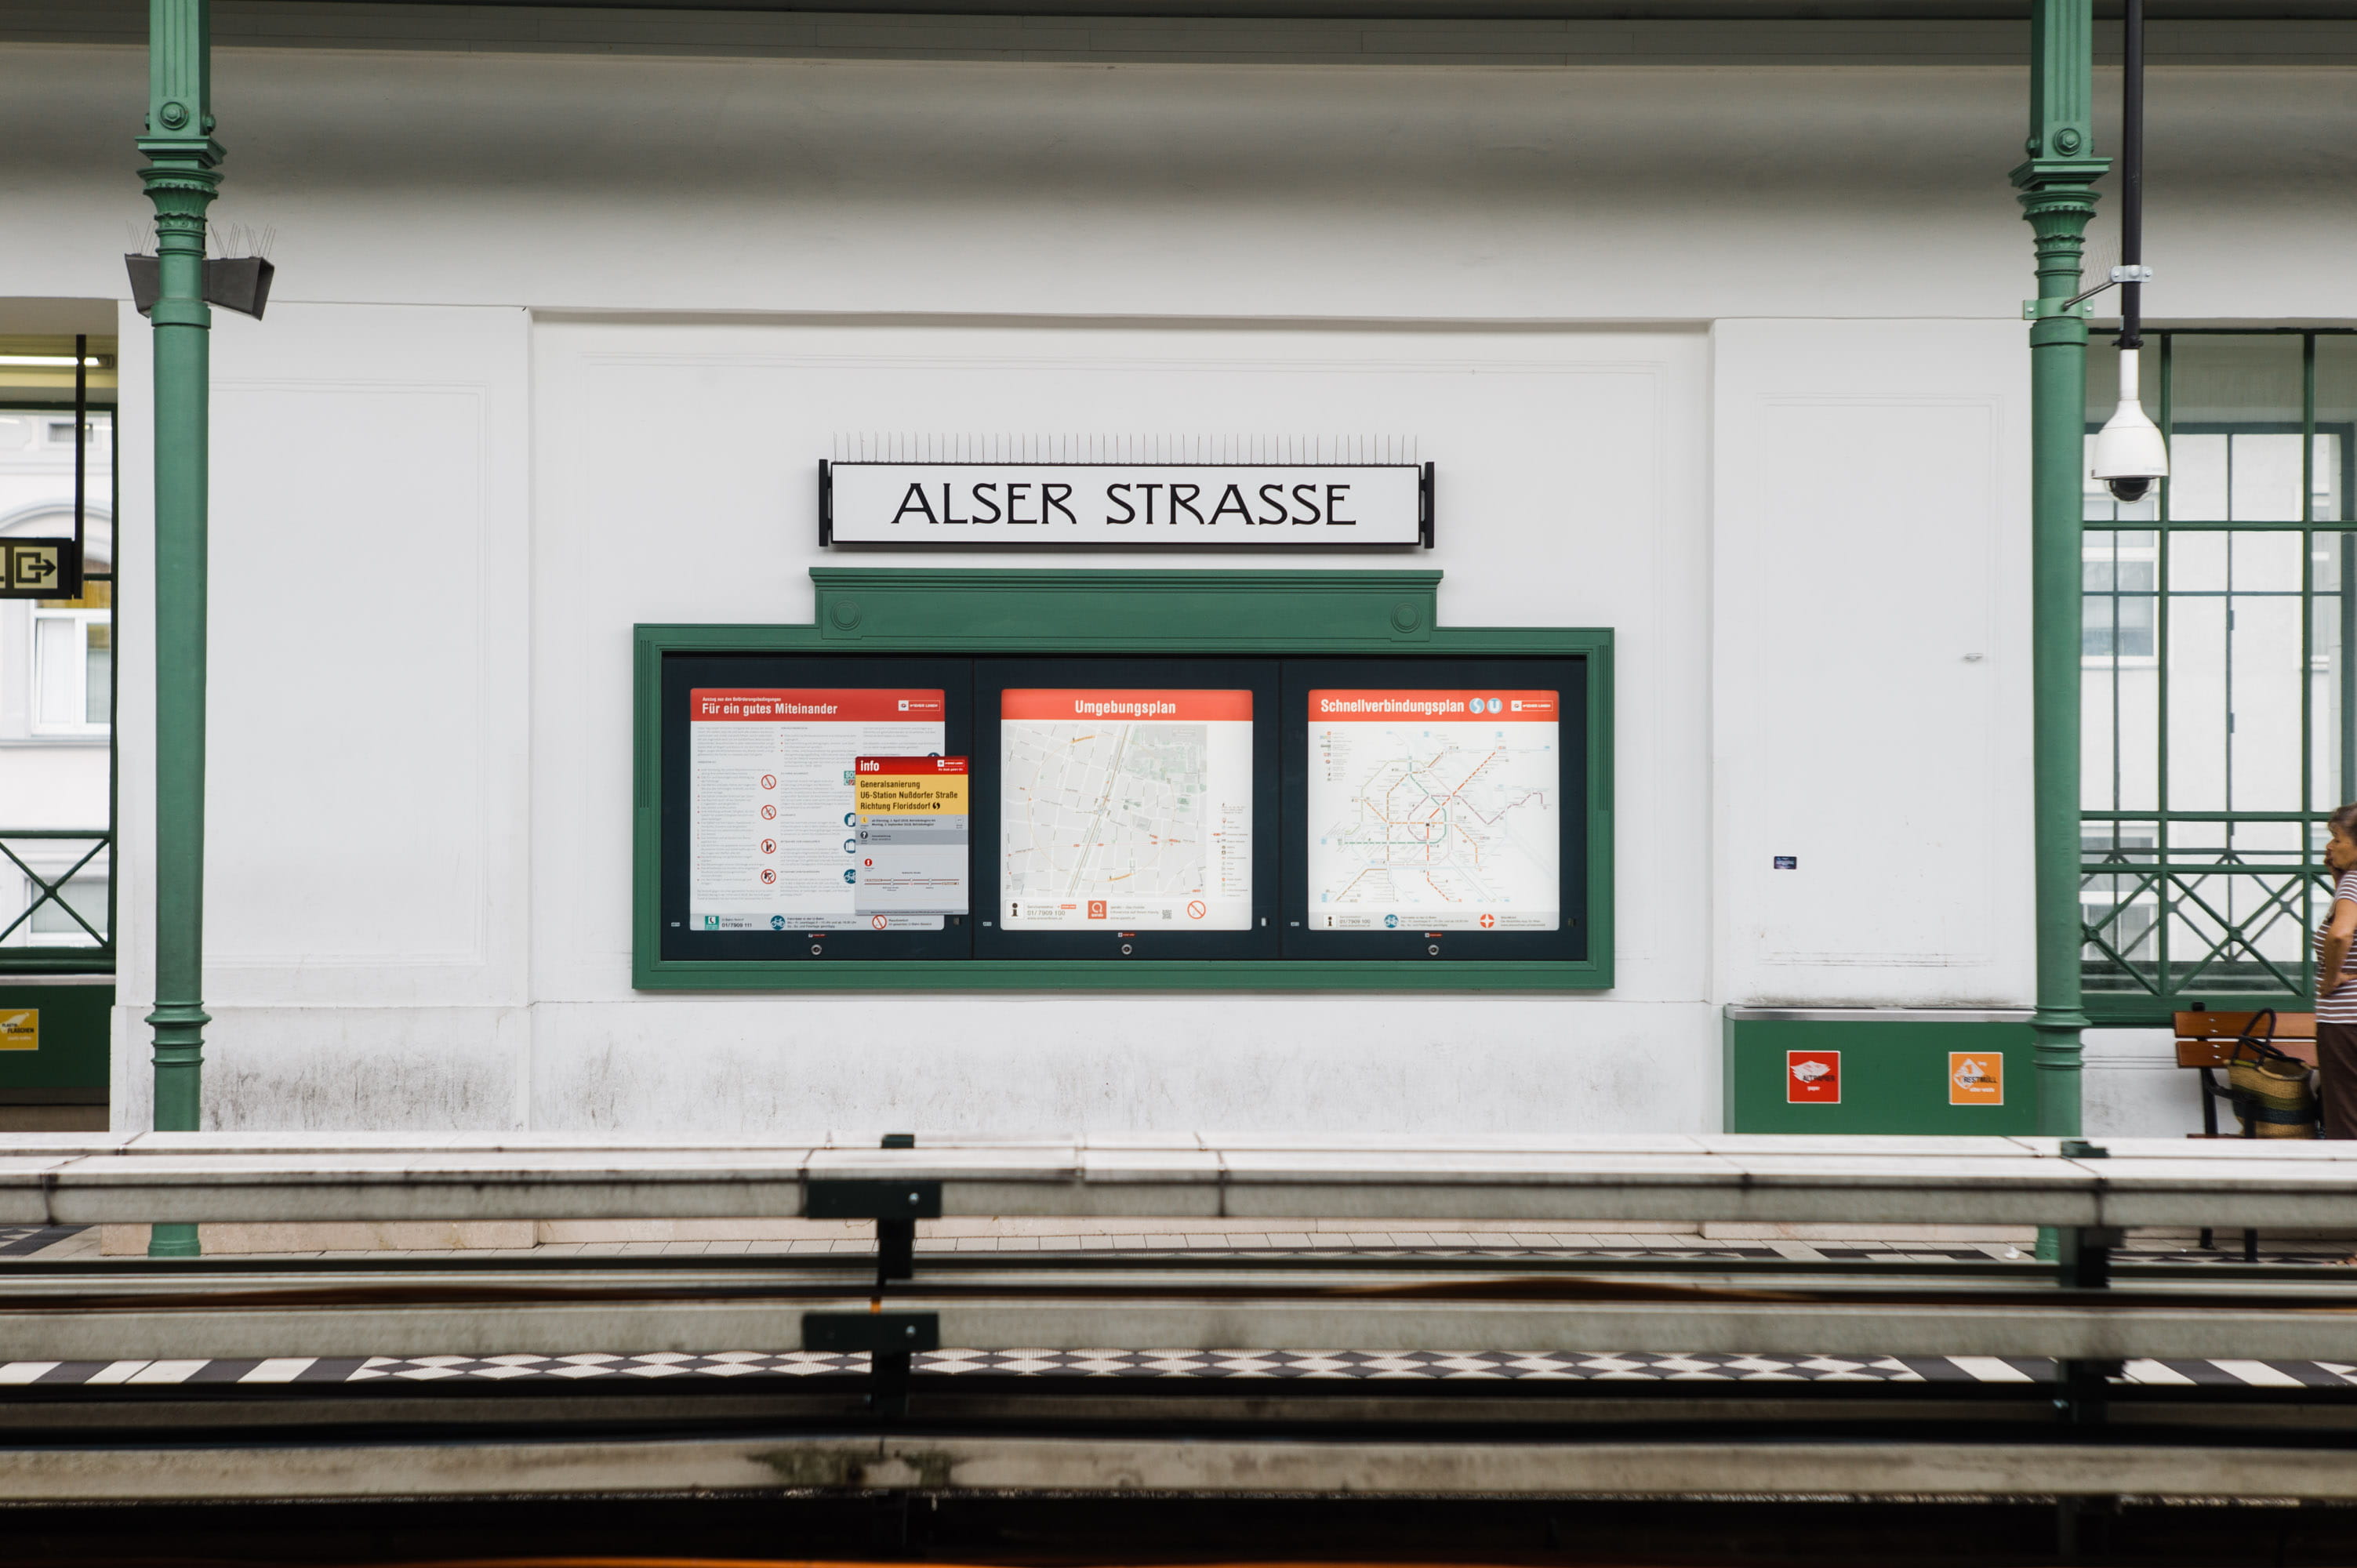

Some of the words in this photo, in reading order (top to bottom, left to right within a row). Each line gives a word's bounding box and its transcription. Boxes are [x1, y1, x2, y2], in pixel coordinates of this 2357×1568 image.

[891, 482, 1077, 524] ALSER
[1106, 483, 1356, 526] STRASSE
[702, 702, 721, 714] Für
[724, 702, 739, 714] ein
[743, 703, 772, 717] gutes
[775, 702, 838, 714] Miteinander
[1075, 699, 1176, 717] Umgebungsplan
[1320, 699, 1465, 715] Schnellverbindungsplan
[860, 760, 880, 771] info
[860, 780, 921, 789] Generalsanierung
[860, 802, 891, 811] Richtung
[1963, 1074, 1997, 1083] RESTMÜLL
